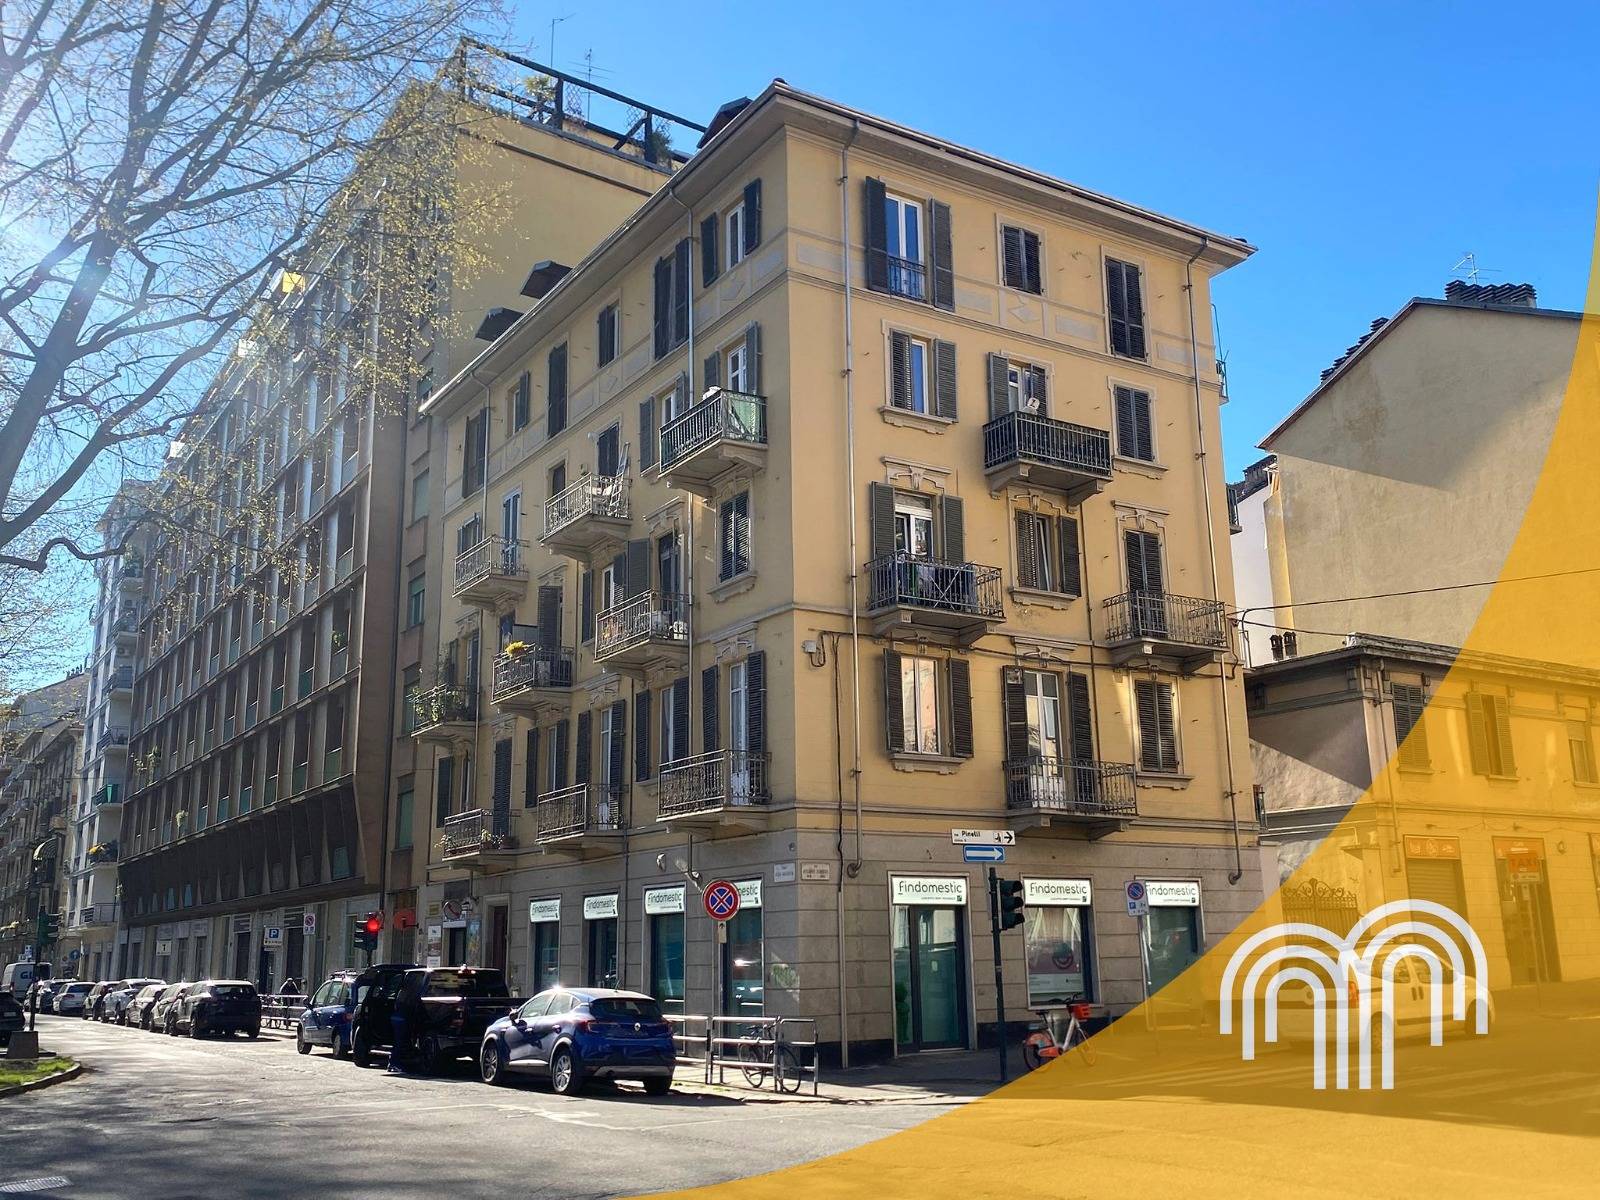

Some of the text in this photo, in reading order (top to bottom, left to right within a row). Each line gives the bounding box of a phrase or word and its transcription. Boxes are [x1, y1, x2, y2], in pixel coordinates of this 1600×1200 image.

[898, 881, 963, 893] Findomestic
[1030, 882, 1087, 894] Findomestic
[647, 891, 682, 904] Findomestic
